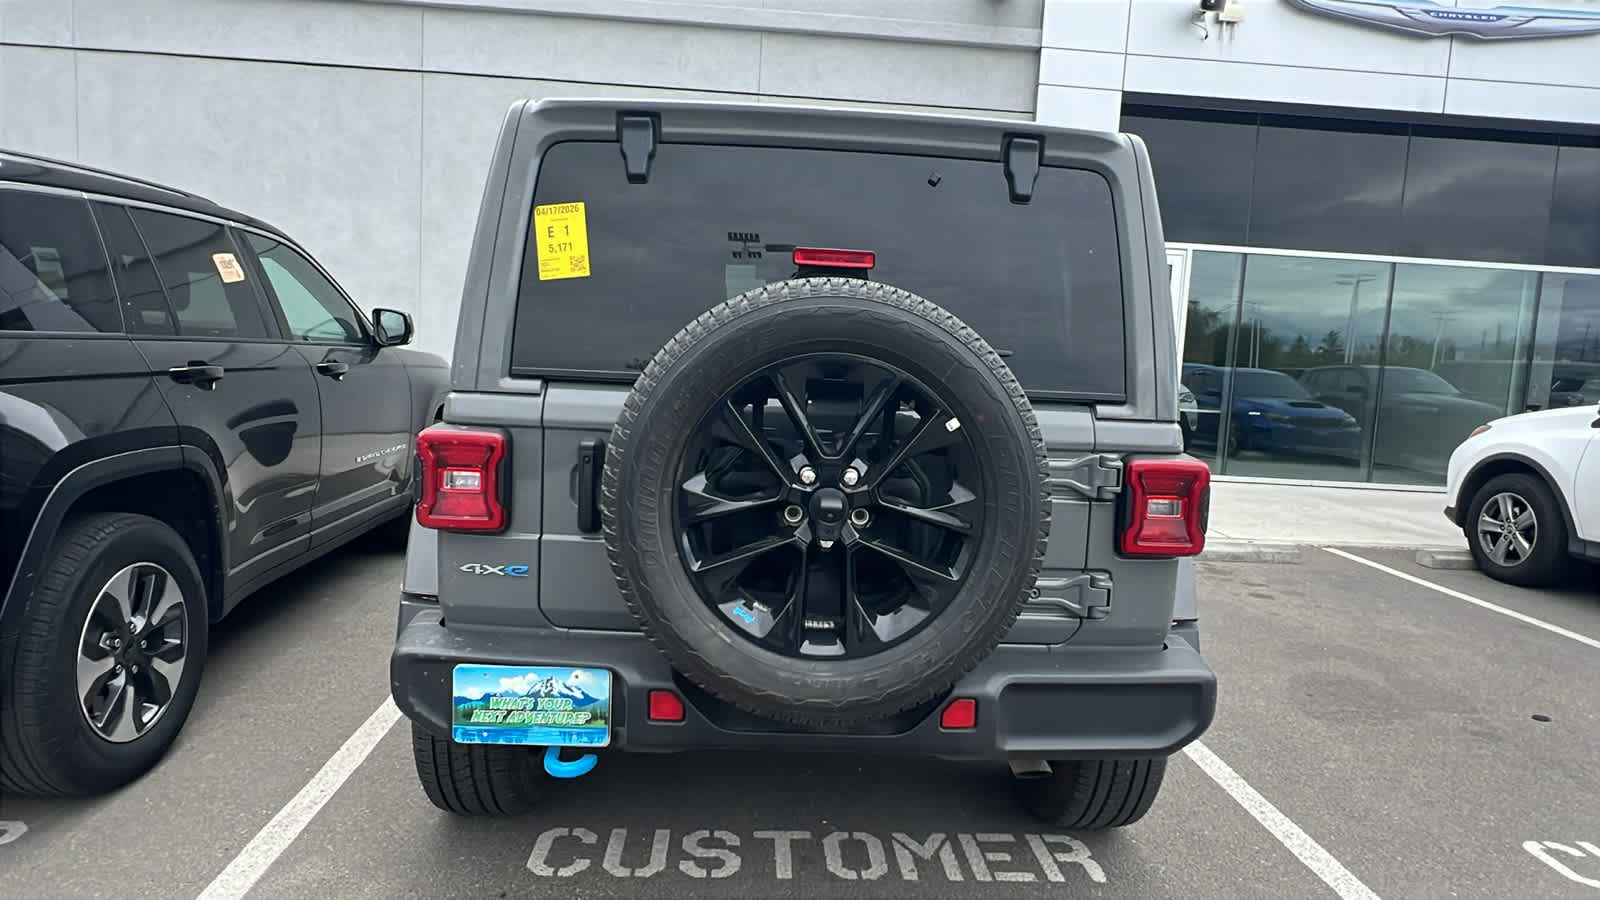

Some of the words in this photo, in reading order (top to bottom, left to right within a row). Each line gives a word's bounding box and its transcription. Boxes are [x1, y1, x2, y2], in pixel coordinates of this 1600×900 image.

[536, 204, 580, 216] 04/17/2026
[547, 225, 555, 238] E
[536, 697, 574, 711] YOUR
[470, 709, 507, 724] NEXT
[507, 710, 593, 726] ADVENTURE?
[526, 828, 1106, 882] CUSTOMER
